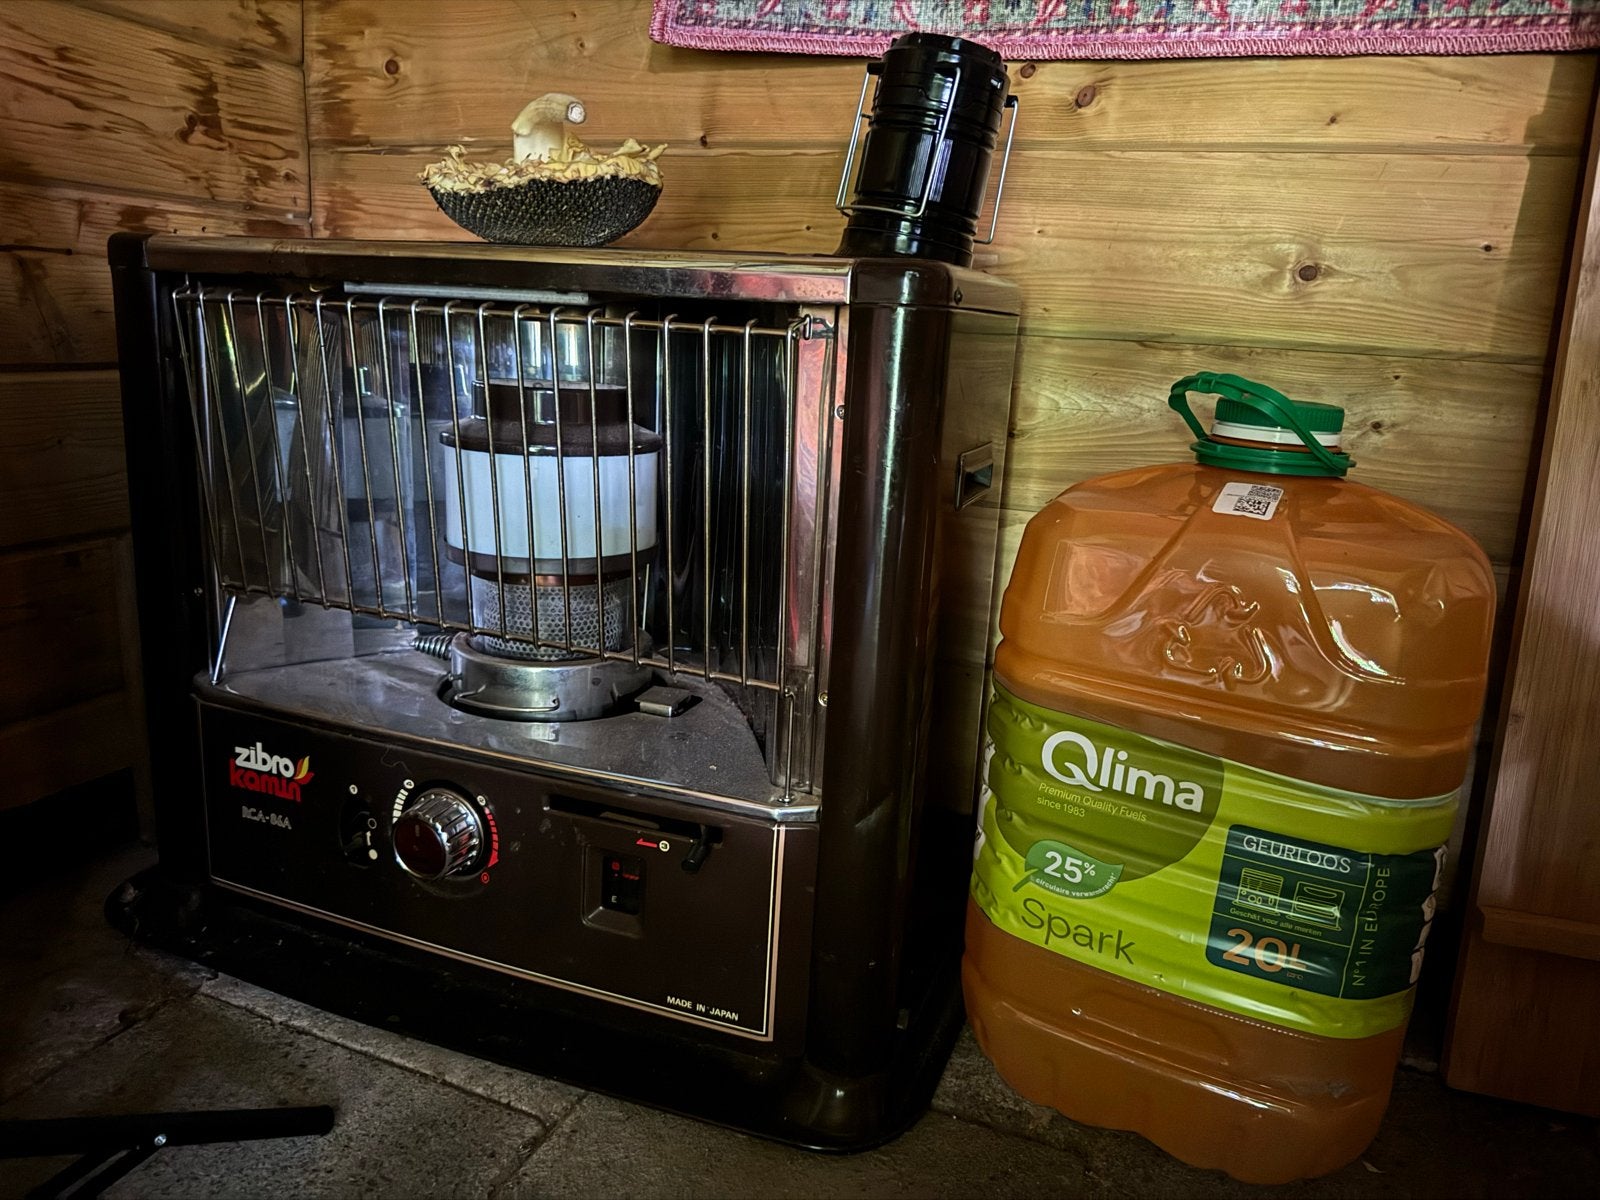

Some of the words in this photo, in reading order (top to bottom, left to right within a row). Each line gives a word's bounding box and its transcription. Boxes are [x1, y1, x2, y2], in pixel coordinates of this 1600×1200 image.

[234, 741, 295, 778] zibro
[1041, 730, 1205, 813] Qlima
[229, 758, 302, 802] kamin
[1036, 796, 1061, 810] since
[1062, 803, 1086, 818] 1983
[1038, 782, 1081, 804] Premium
[1082, 795, 1119, 815] Quality
[1119, 806, 1147, 822] Fuels
[1043, 851, 1096, 884] 25%
[1243, 835, 1352, 873] GEURLOOS
[1035, 877, 1070, 896] circulaire
[1361, 867, 1391, 932] EUROPE
[1020, 897, 1136, 965] Spark
[1222, 927, 1307, 973] 20L
[1358, 939, 1375, 955] IN
[666, 995, 693, 1009] MADE
[696, 1003, 706, 1013] IN
[709, 1006, 739, 1021] JAPAN
